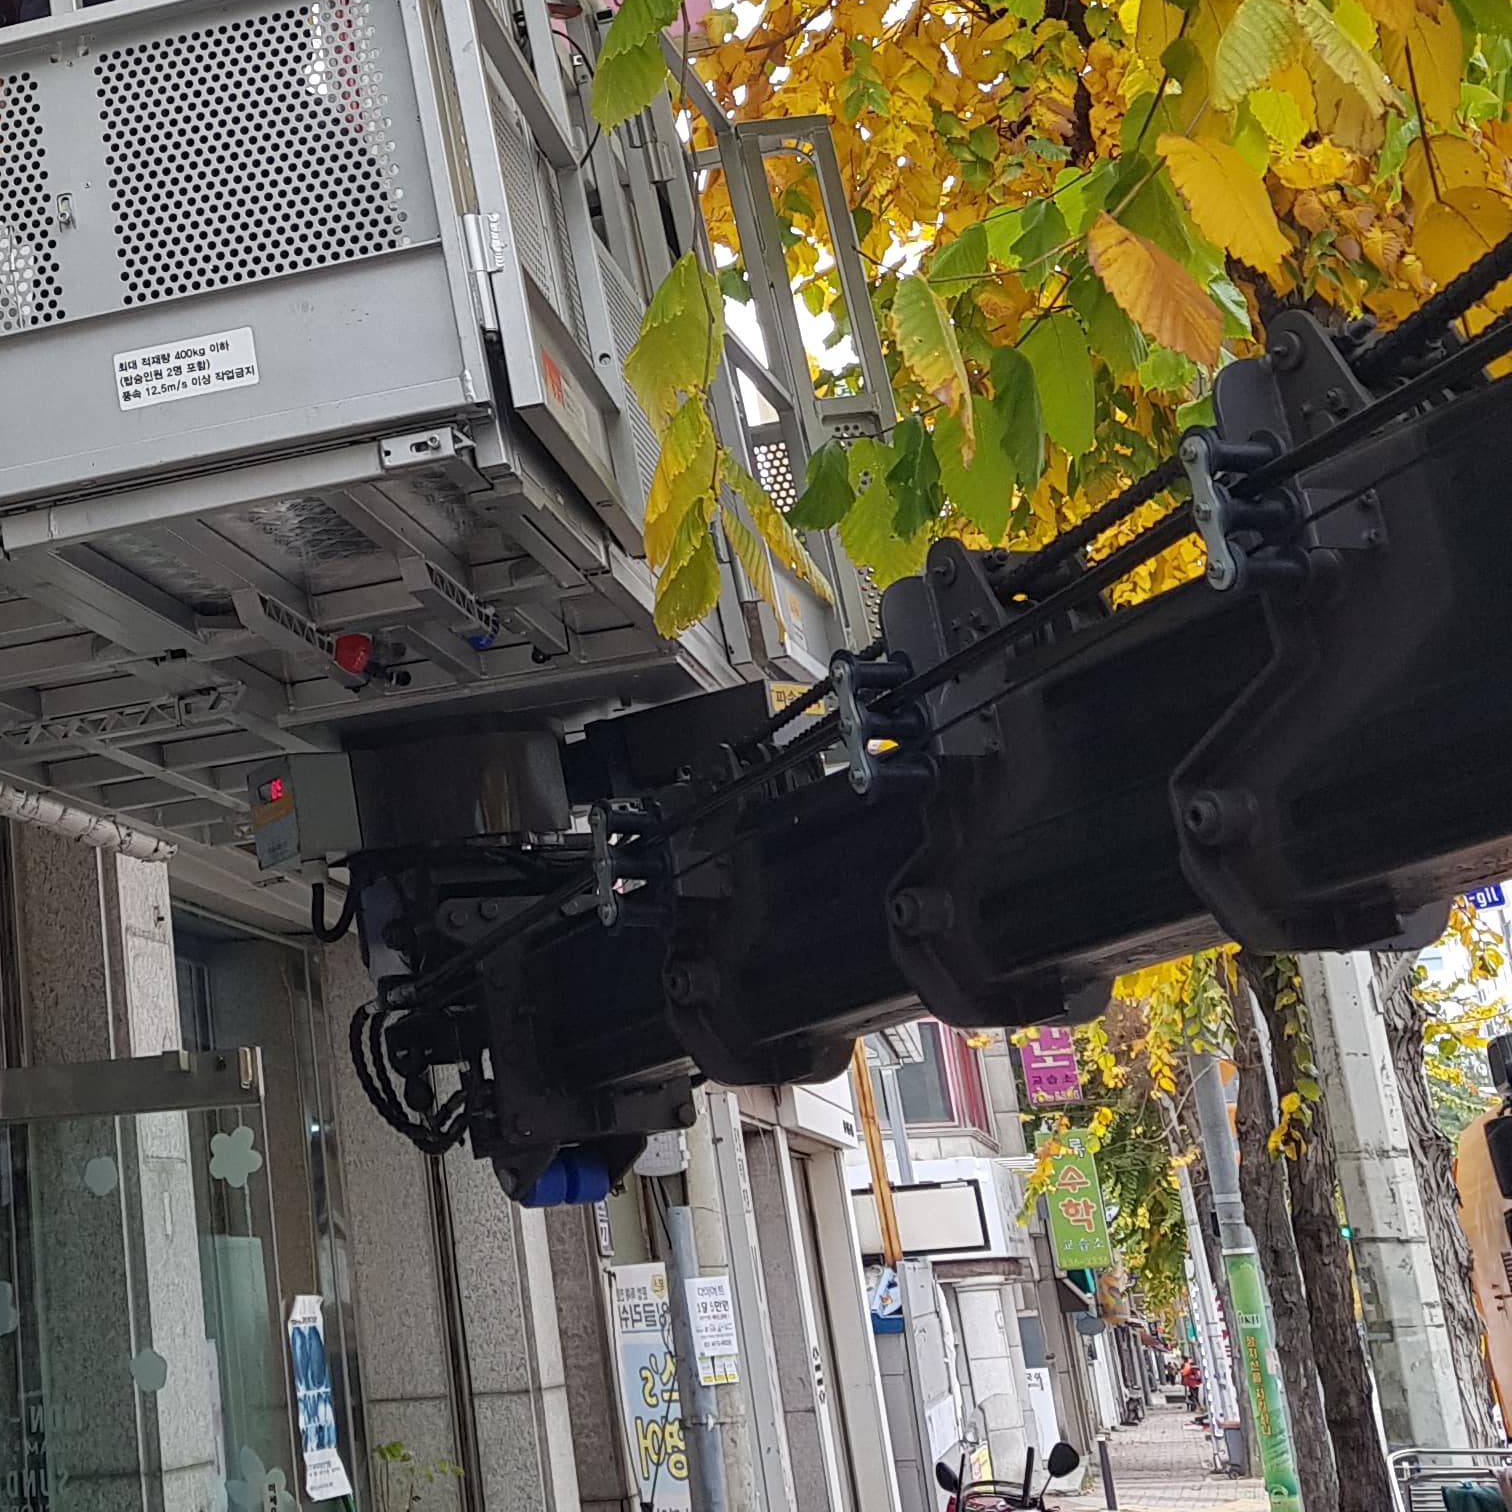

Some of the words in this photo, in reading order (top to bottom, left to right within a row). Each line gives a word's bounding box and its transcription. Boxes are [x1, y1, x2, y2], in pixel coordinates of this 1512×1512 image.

[118, 361, 137, 373] 최대
[141, 353, 171, 367] 적재량
[174, 346, 206, 361] 400kg
[209, 339, 230, 354] 이하
[119, 370, 164, 388] (탑승인원
[166, 364, 183, 378] 2명
[186, 358, 211, 374] 포함)
[122, 390, 142, 402] 풍속
[145, 379, 188, 397] 12.5m/s
[191, 374, 211, 387] 이상
[215, 365, 255, 382] 작업금지
[1056, 1165, 1096, 1233] 수학
